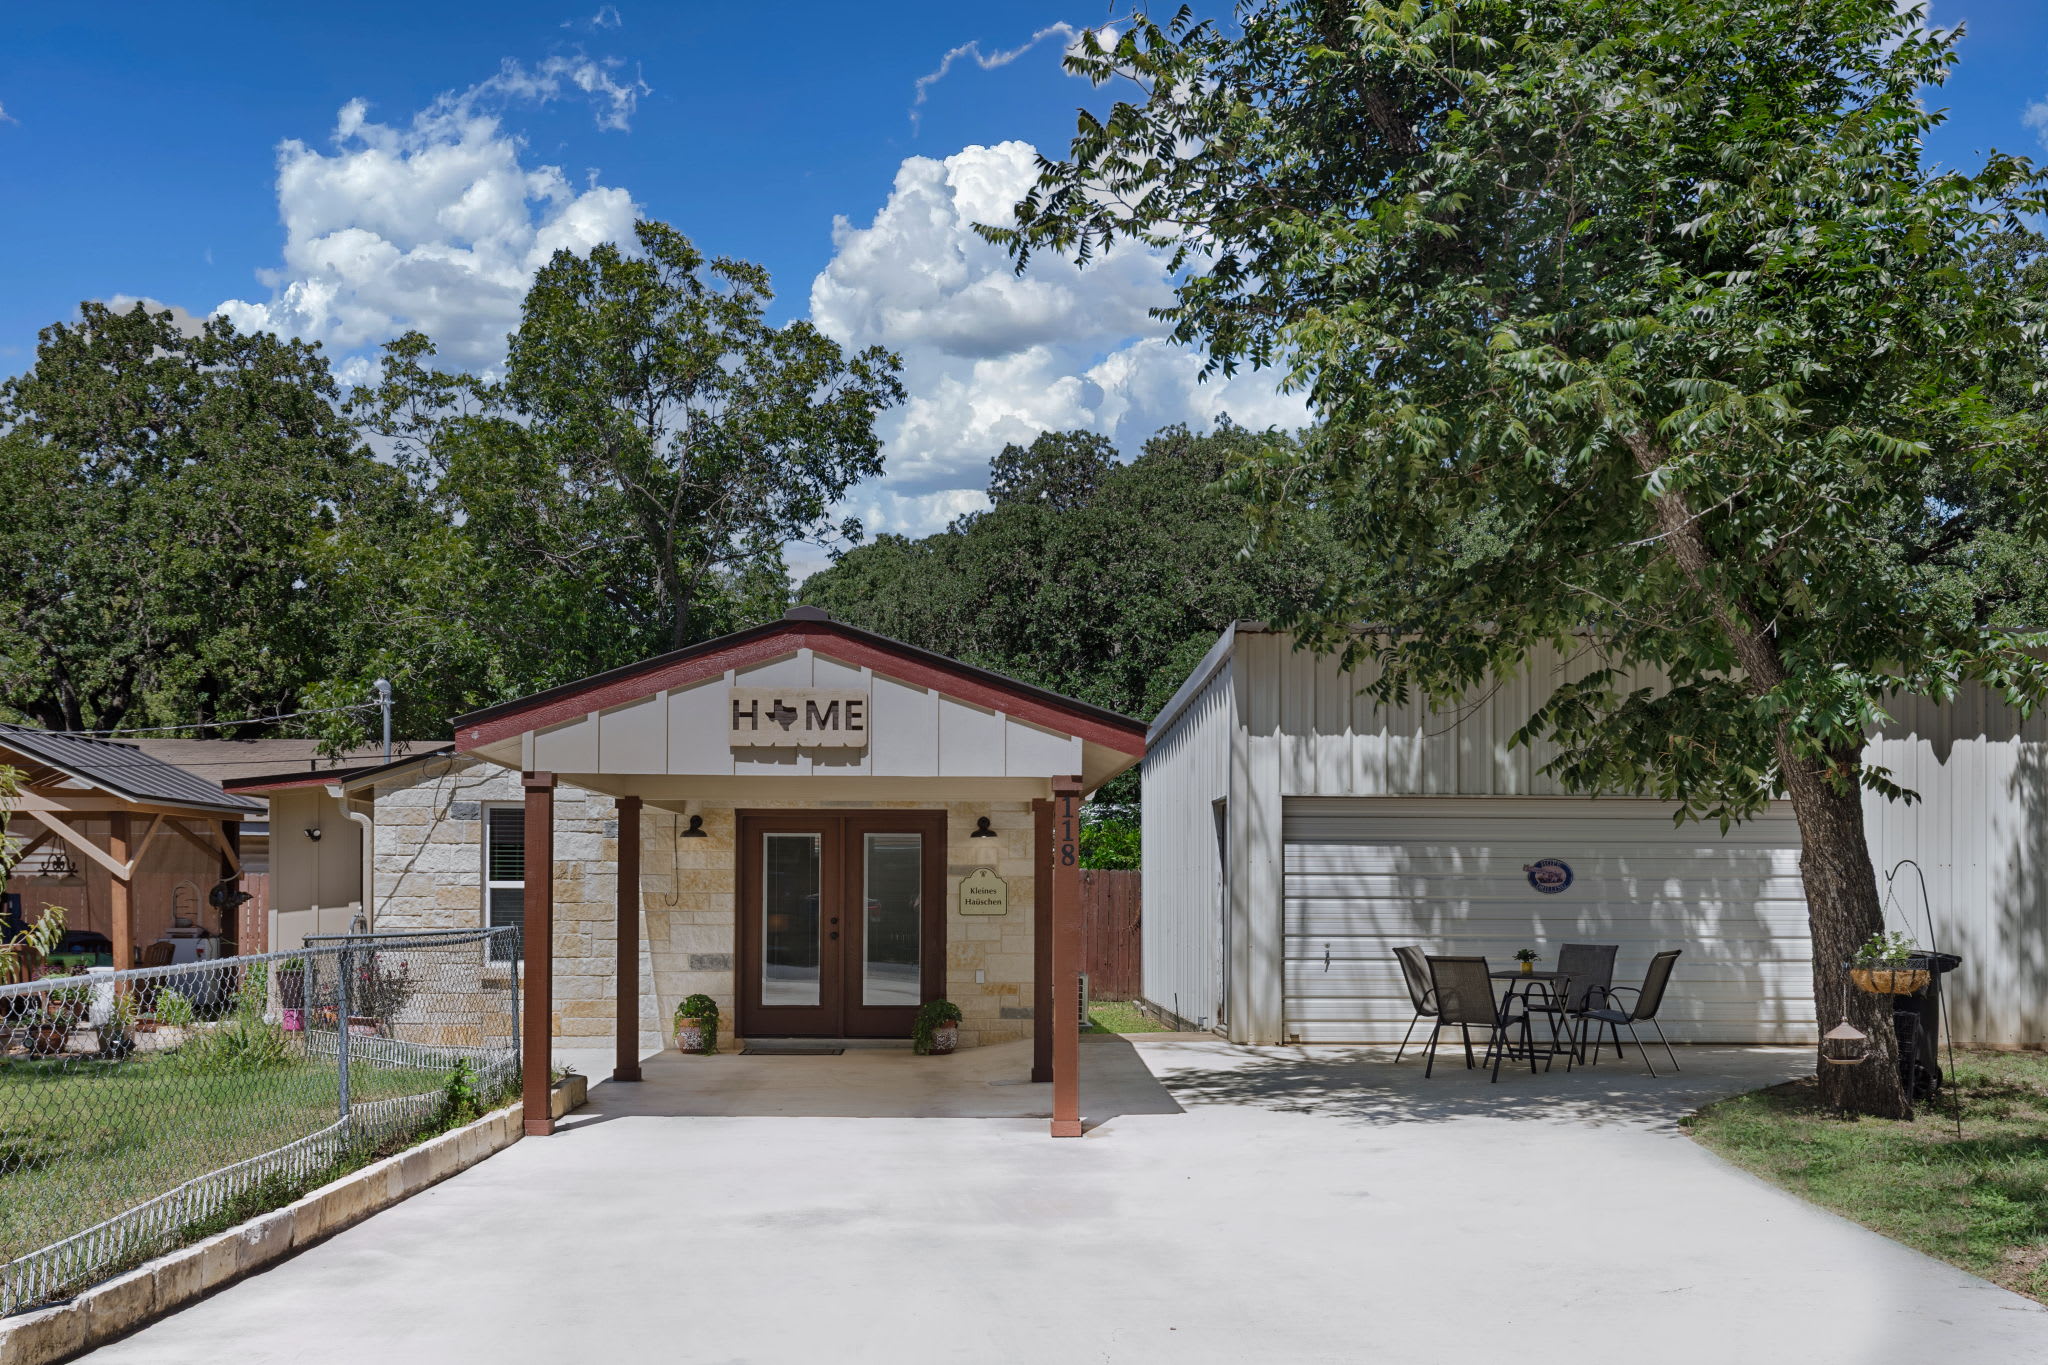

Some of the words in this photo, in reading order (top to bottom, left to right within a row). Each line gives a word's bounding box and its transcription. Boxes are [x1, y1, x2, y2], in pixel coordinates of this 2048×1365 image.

[732, 698, 864, 731] HME
[1061, 795, 1076, 866] 118
[970, 887, 998, 895] Kleines
